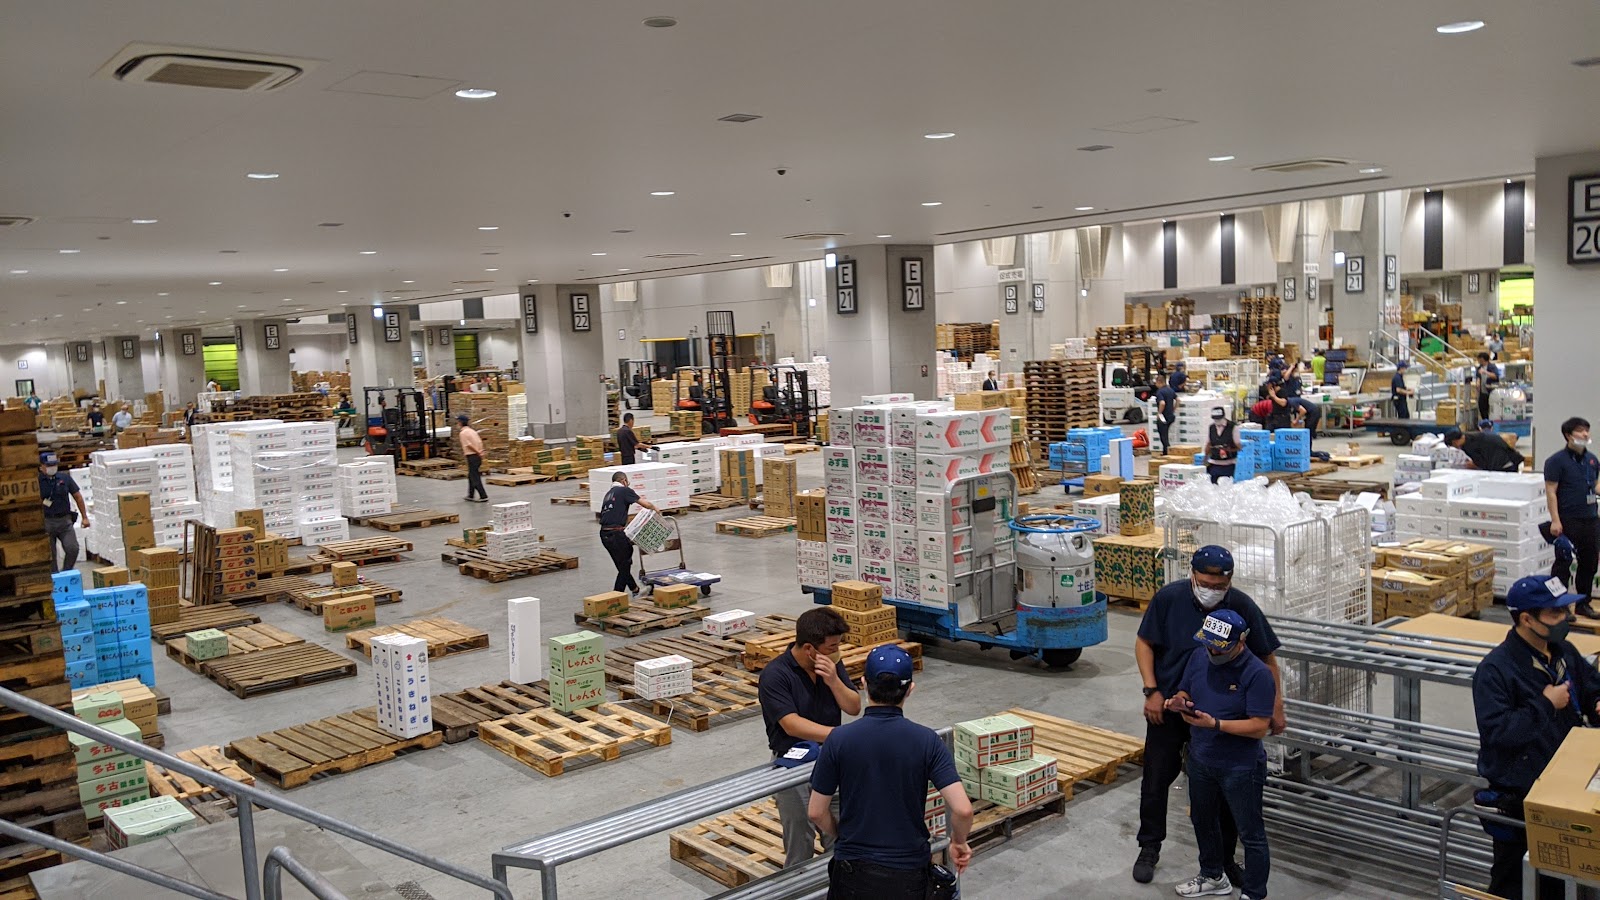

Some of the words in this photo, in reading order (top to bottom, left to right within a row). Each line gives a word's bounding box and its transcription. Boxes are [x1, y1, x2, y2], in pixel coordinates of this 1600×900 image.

[1350, 261, 1360, 272] D
[1388, 258, 1394, 270] D
[842, 266, 850, 283] E
[910, 264, 917, 280] E
[1036, 285, 1042, 295] D
[1348, 278, 1362, 291] 21
[908, 288, 921, 306] 21
[1008, 288, 1014, 298] D
[527, 298, 533, 312] E
[577, 297, 584, 310] E
[840, 291, 852, 309] 21
[1006, 300, 1016, 310] 22
[1036, 298, 1044, 310] 22
[390, 315, 397, 326] E
[526, 315, 535, 327] 22
[575, 314, 588, 328] 22
[269, 327, 276, 336] E
[388, 329, 399, 340] 23
[268, 338, 278, 348] 24
[858, 416, 880, 424] こまつ菜
[861, 454, 882, 462] こまつ菜
[862, 491, 883, 499] こまつ菜
[864, 530, 886, 538] こまつ菜
[1402, 556, 1422, 567] 大根
[864, 565, 886, 575] こまつ菜
[1382, 580, 1403, 590] 大根
[568, 654, 601, 668] しゅんぎく
[570, 688, 602, 702] しゅんぎく
